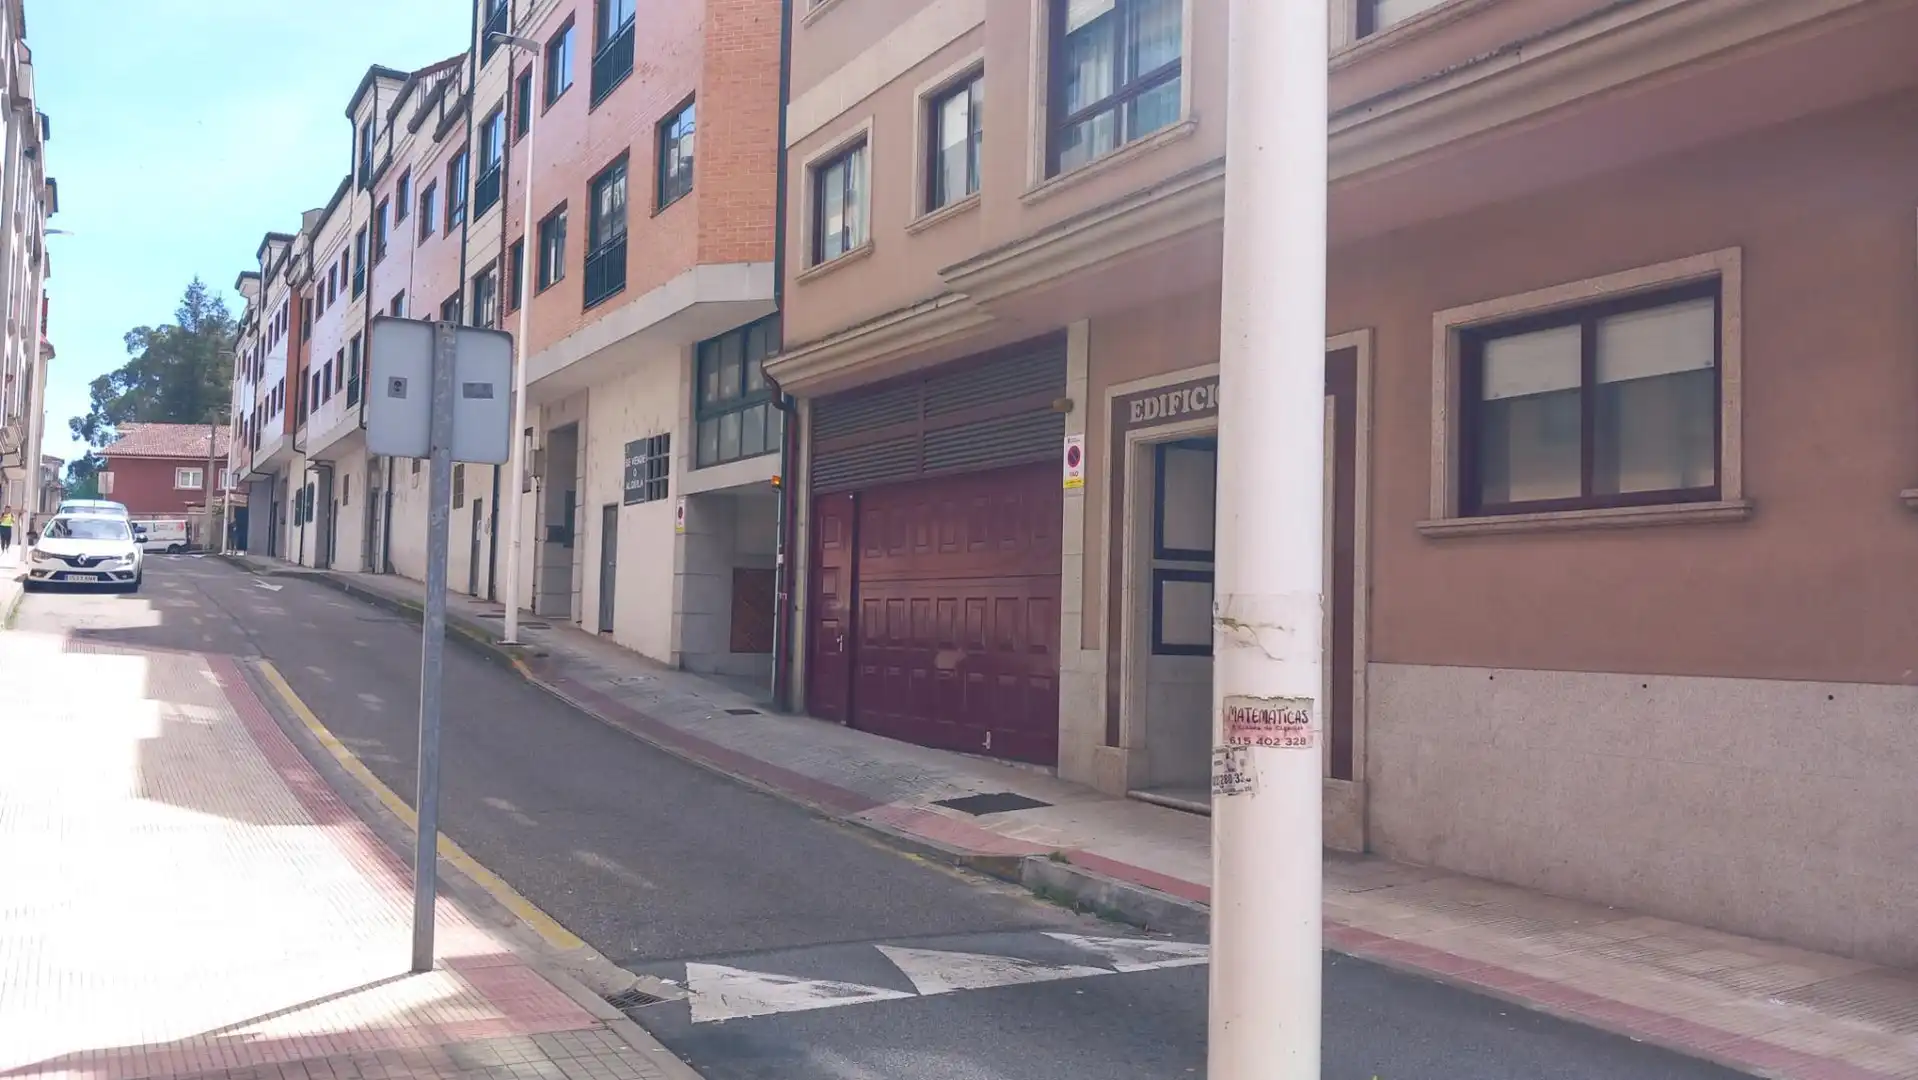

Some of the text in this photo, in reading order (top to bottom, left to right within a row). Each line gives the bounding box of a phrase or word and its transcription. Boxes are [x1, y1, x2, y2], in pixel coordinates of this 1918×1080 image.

[1129, 384, 1219, 424] EDIFICI
[1229, 736, 1306, 746] 615 402 328
